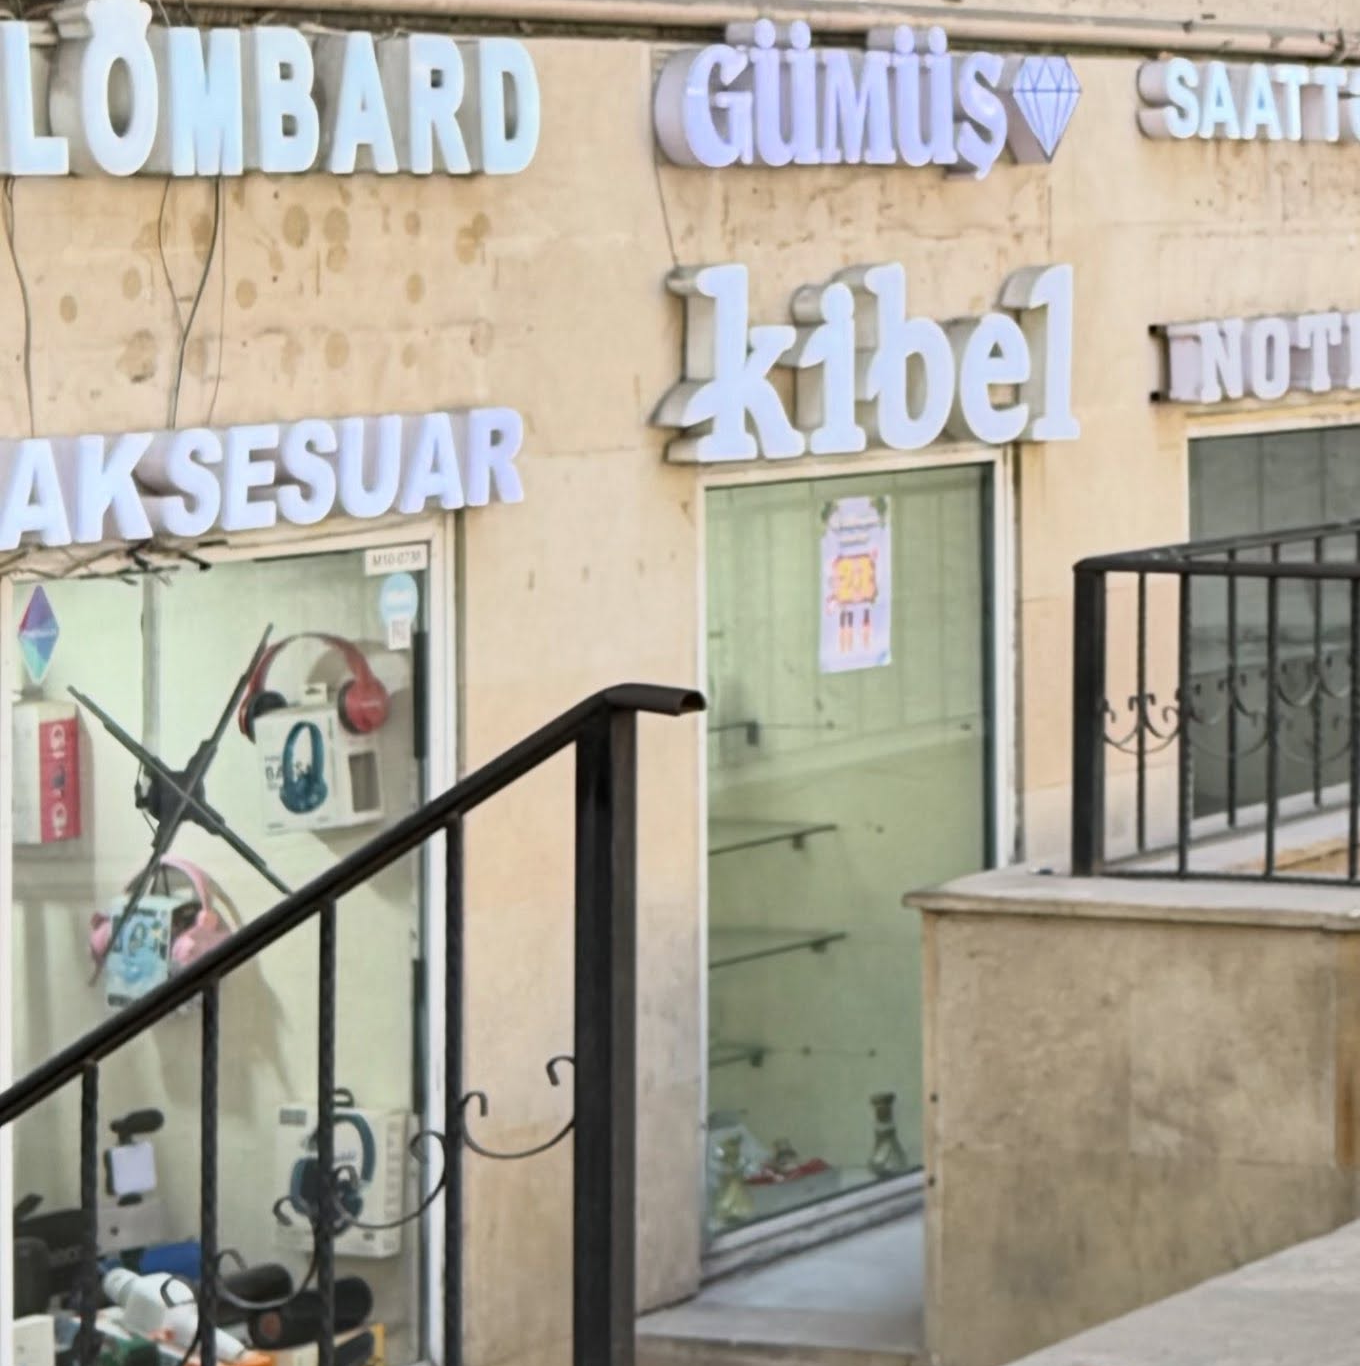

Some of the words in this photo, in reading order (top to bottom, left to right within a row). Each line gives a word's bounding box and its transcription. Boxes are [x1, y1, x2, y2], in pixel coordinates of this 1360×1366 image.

[684, 19, 1008, 180] GÜMÜŞ
[682, 263, 1082, 462] kibel
[0, 407, 525, 551] AKSESUAR
